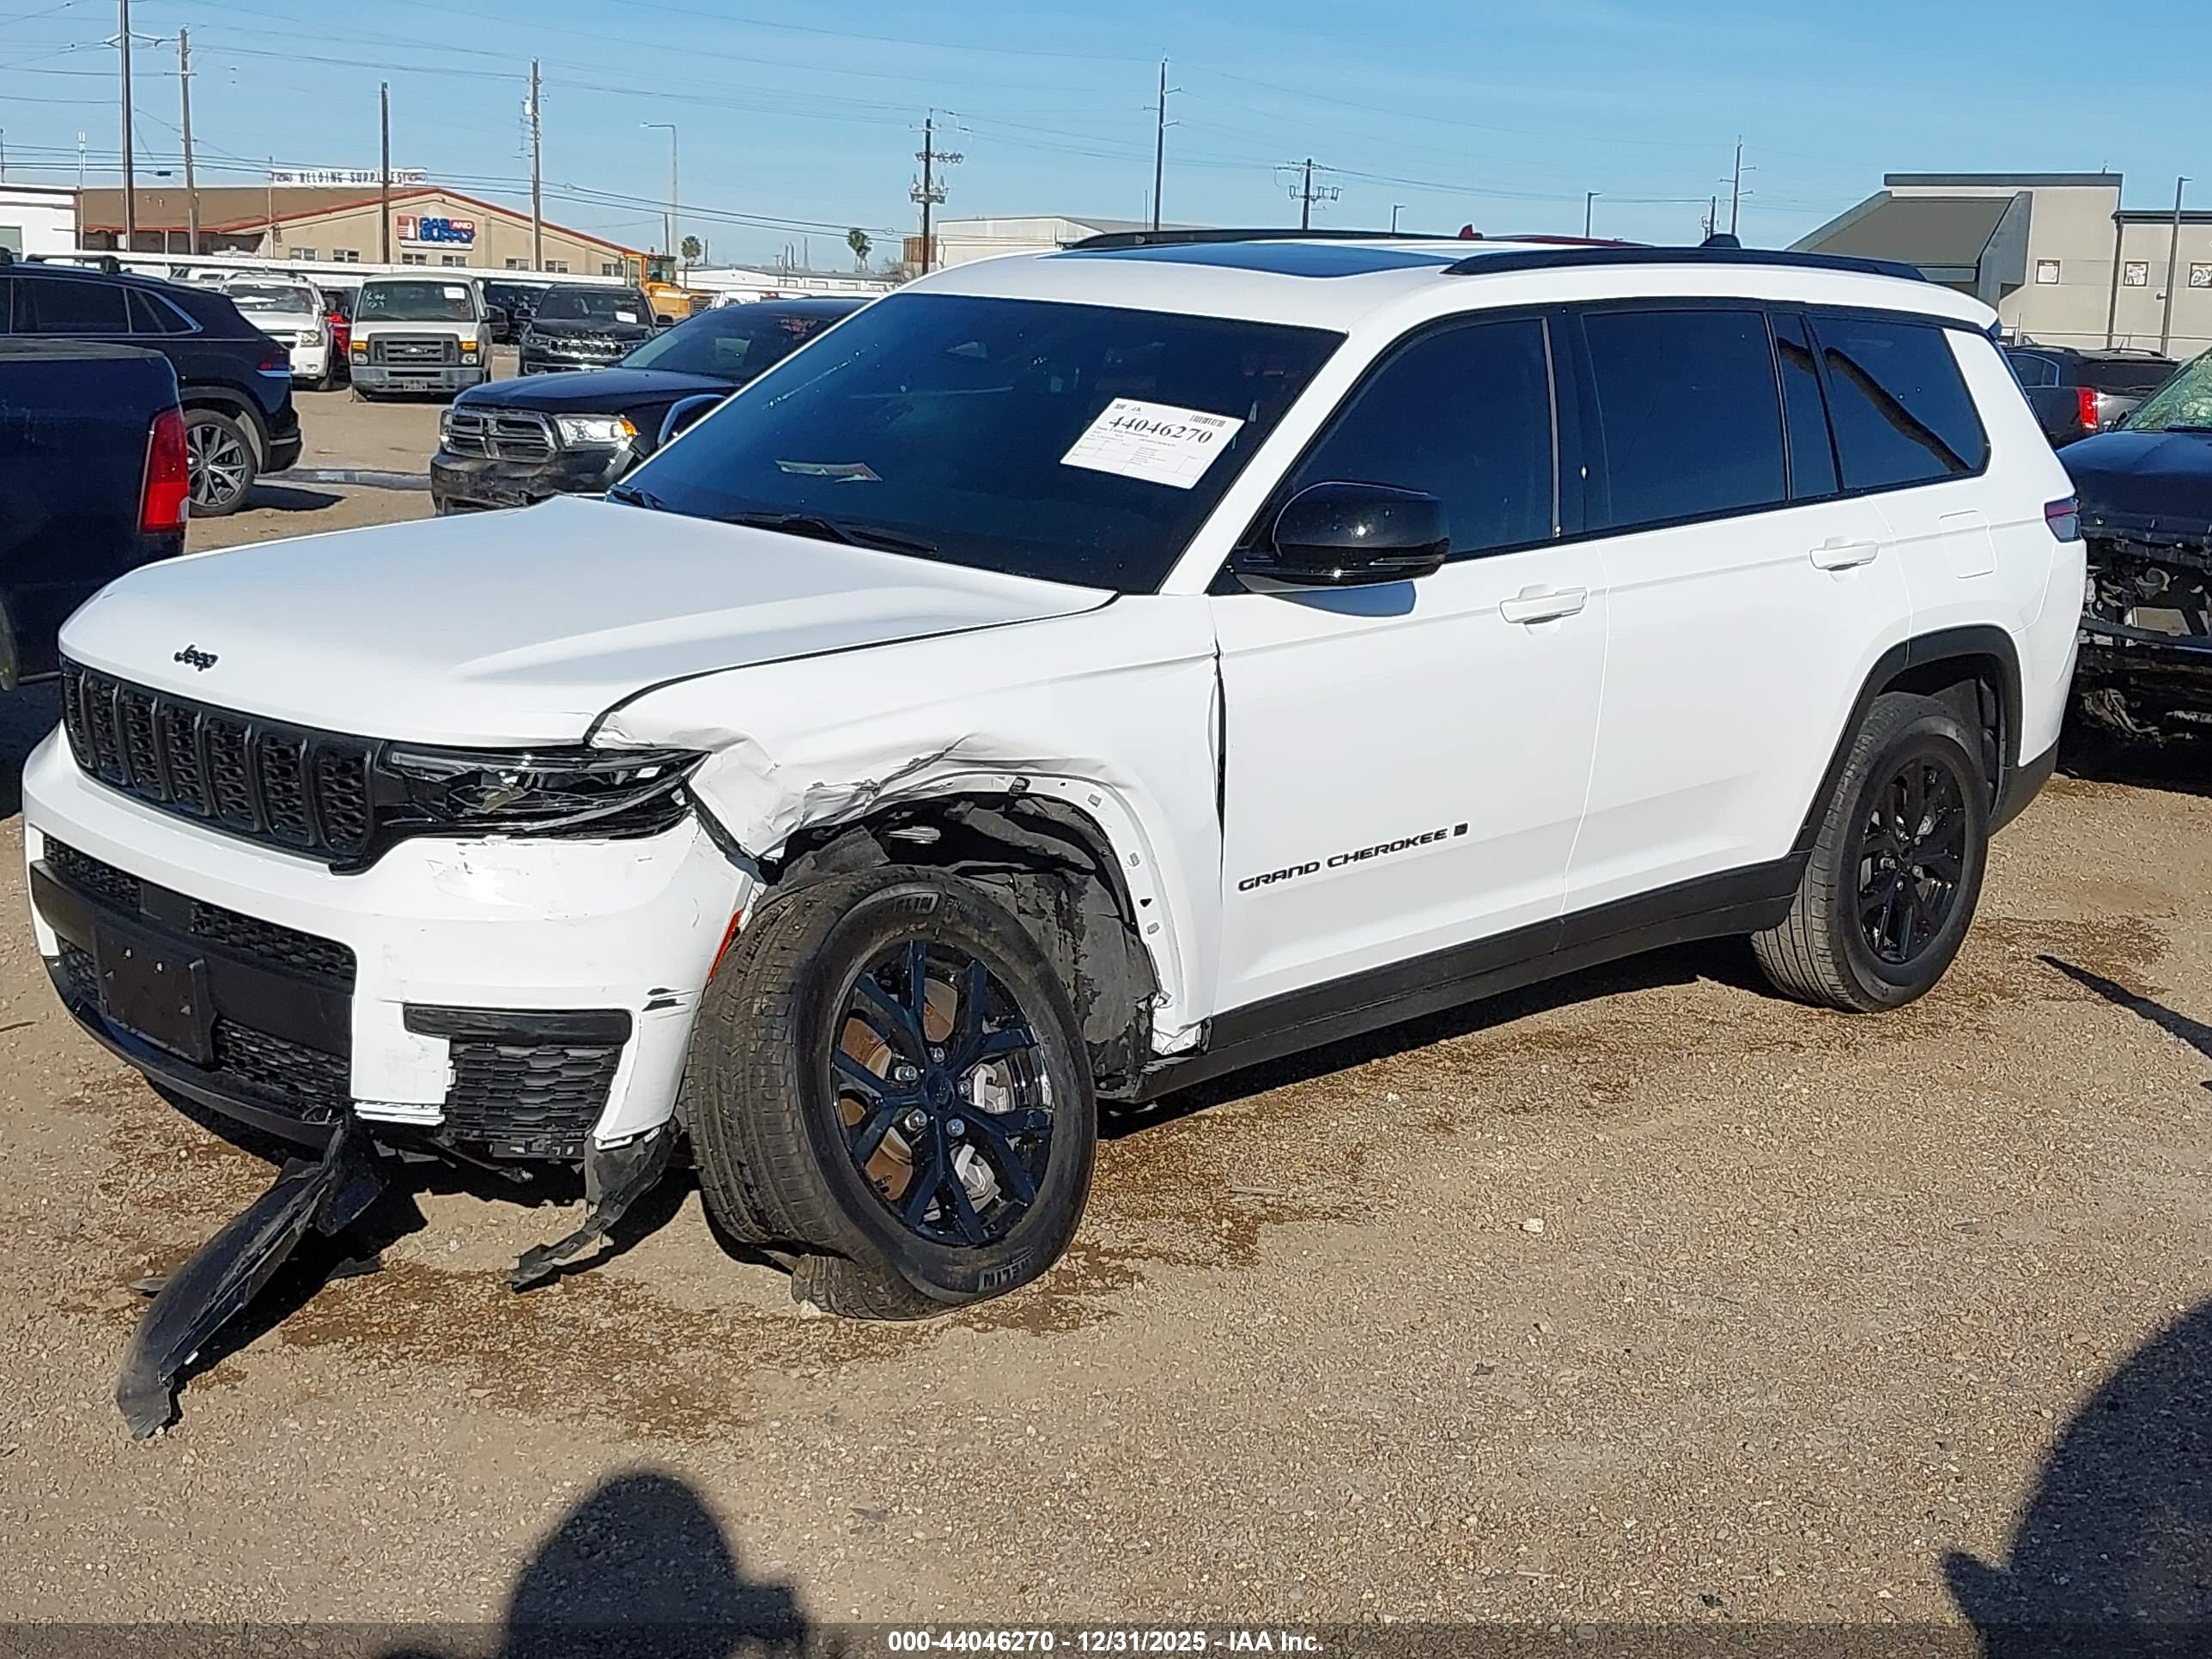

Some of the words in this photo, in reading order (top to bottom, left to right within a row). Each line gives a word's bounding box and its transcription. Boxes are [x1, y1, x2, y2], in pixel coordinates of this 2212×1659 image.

[350, 171, 402, 184] SUPPLES
[452, 222, 473, 230] AND
[1109, 415, 1213, 444] 44046270
[173, 644, 219, 672] Jeep
[1237, 860, 1321, 892] GRAND
[1327, 828, 1448, 868] CHEROKEE
